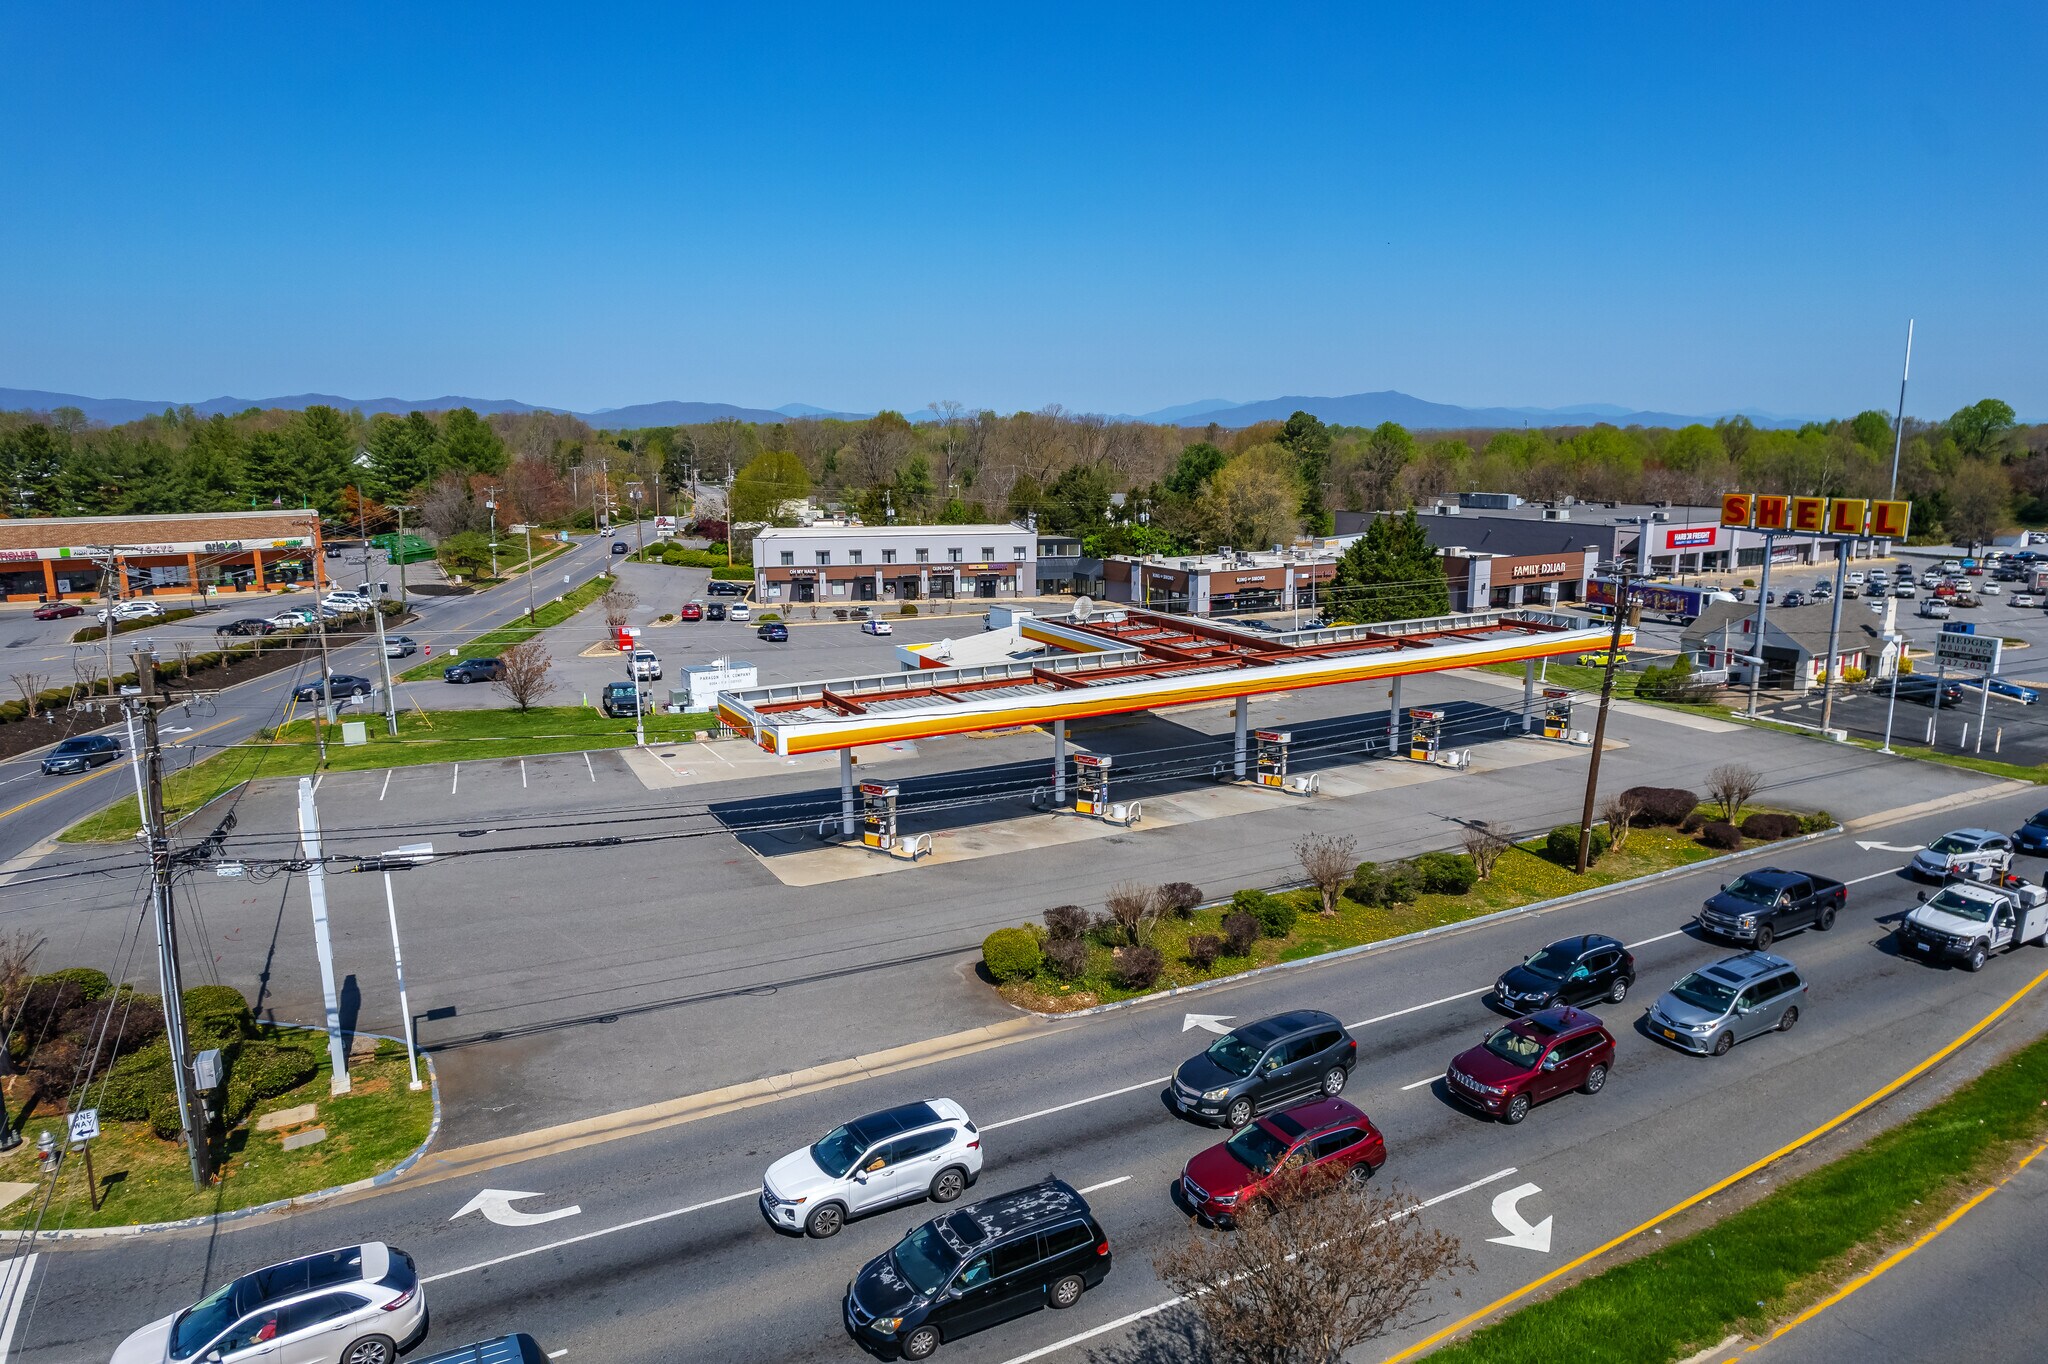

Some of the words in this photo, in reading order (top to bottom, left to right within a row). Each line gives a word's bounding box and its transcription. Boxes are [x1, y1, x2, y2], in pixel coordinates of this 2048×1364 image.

[1725, 497, 1897, 534] SHELL
[1692, 531, 1711, 540] FREIGHT
[139, 544, 175, 554] TOKYO
[1513, 564, 1540, 576] FAMILY
[1541, 561, 1566, 574] DOLLAR
[1947, 635, 1993, 648] HEDGES
[1936, 642, 1995, 656] INSURANCE
[1940, 657, 1988, 671] 237-2021
[74, 1111, 92, 1122] ONE
[73, 1119, 93, 1129] WAY
